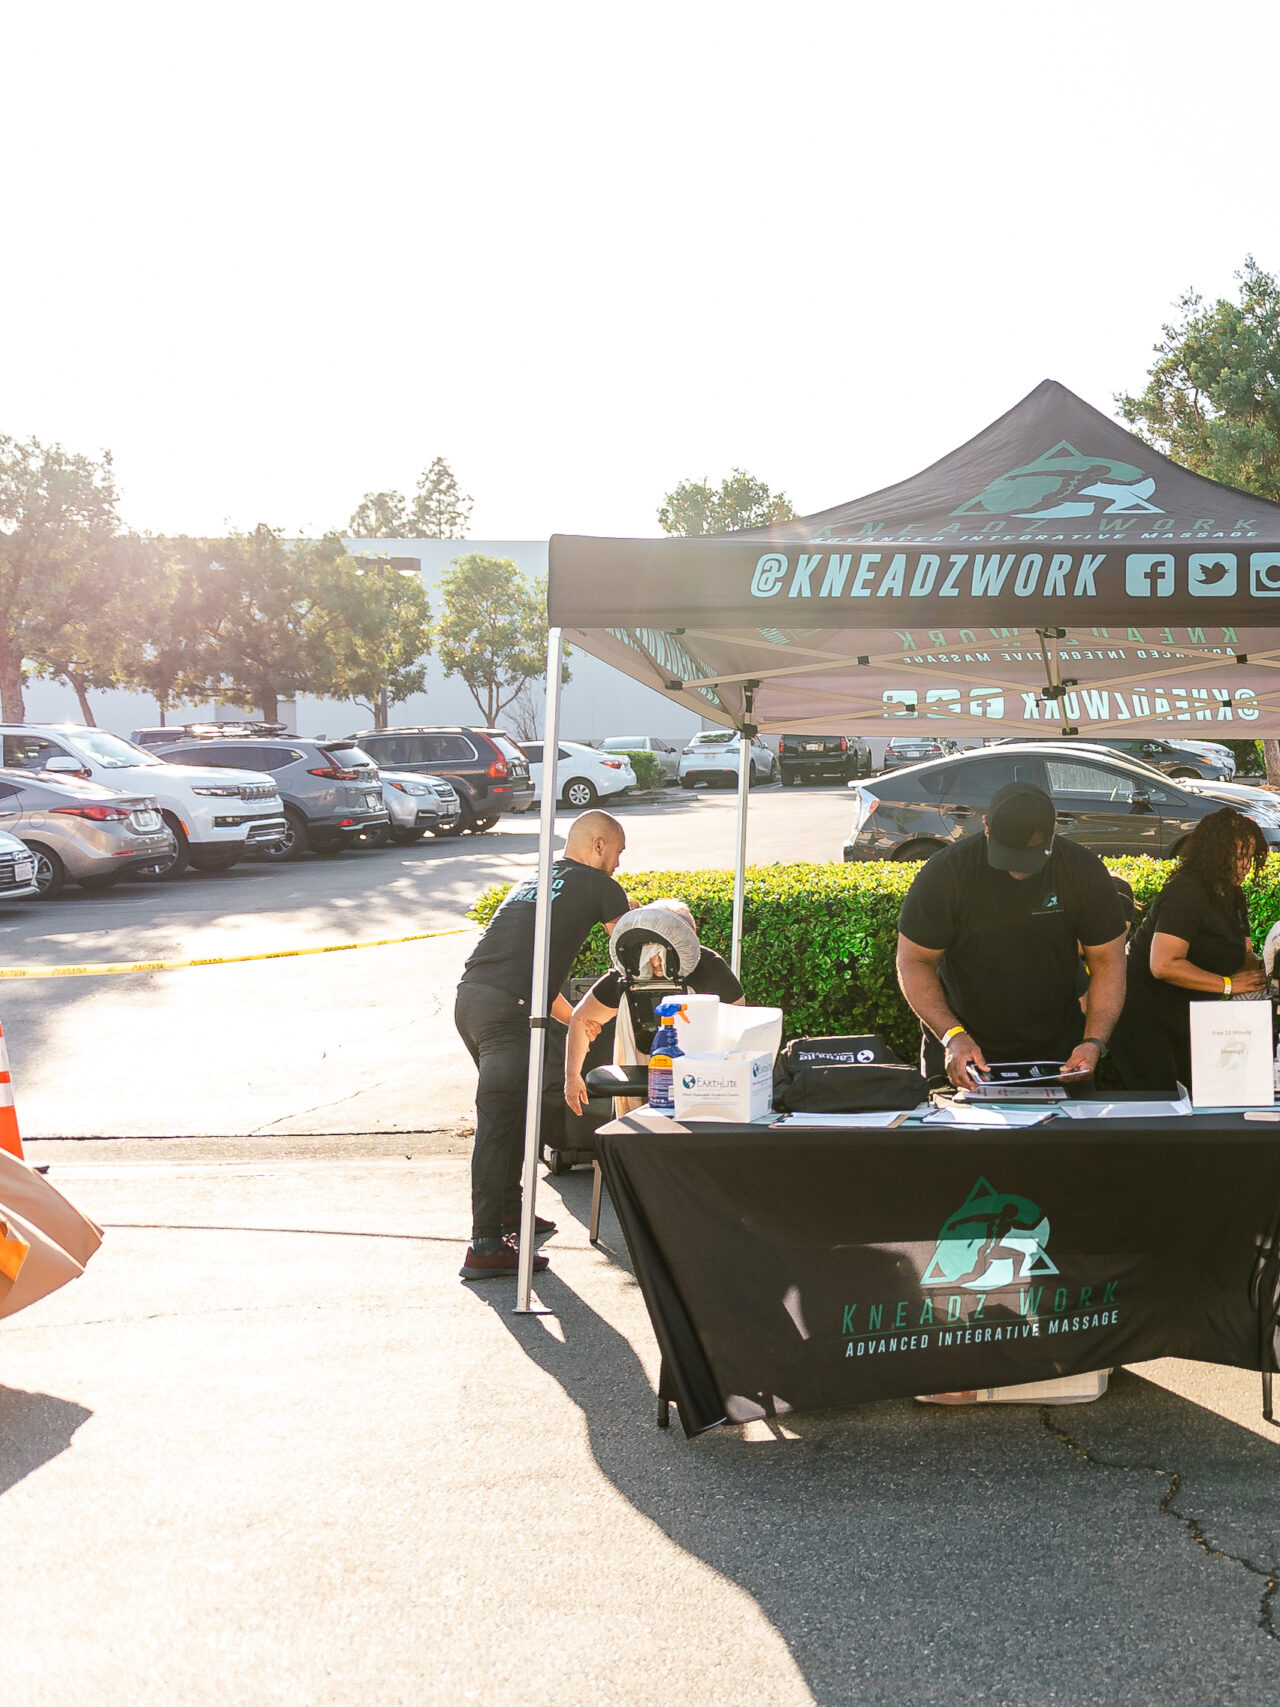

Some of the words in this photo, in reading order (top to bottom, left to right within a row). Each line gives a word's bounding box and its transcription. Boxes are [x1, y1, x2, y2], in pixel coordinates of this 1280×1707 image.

[813, 519, 1047, 537] KNEADZ
[1098, 518, 1258, 531] WORK
[959, 533, 1126, 542] INTEGRATIVE
[1140, 531, 1258, 539] MASSAGE
[750, 553, 1107, 597] @KNEADZWORK
[841, 1294, 988, 1334] KNEADZ
[1019, 1281, 1119, 1316] WORK
[845, 1335, 929, 1358] ADVANCED
[938, 1323, 1040, 1347] INTEGRATIVE
[1048, 1310, 1119, 1334] MASSAGE
